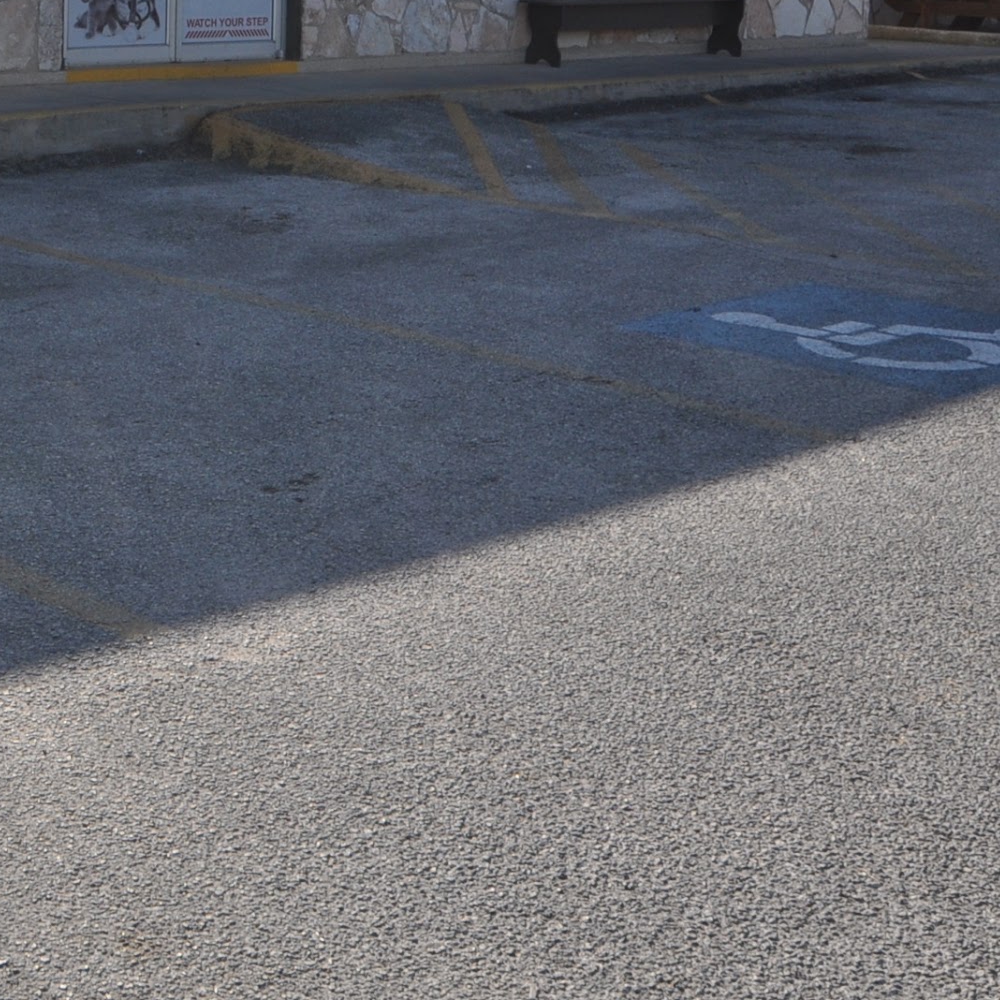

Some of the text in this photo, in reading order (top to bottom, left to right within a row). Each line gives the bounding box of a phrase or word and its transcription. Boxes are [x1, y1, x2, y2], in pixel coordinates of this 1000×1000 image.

[186, 17, 269, 28] WATCH YOUR STEP
